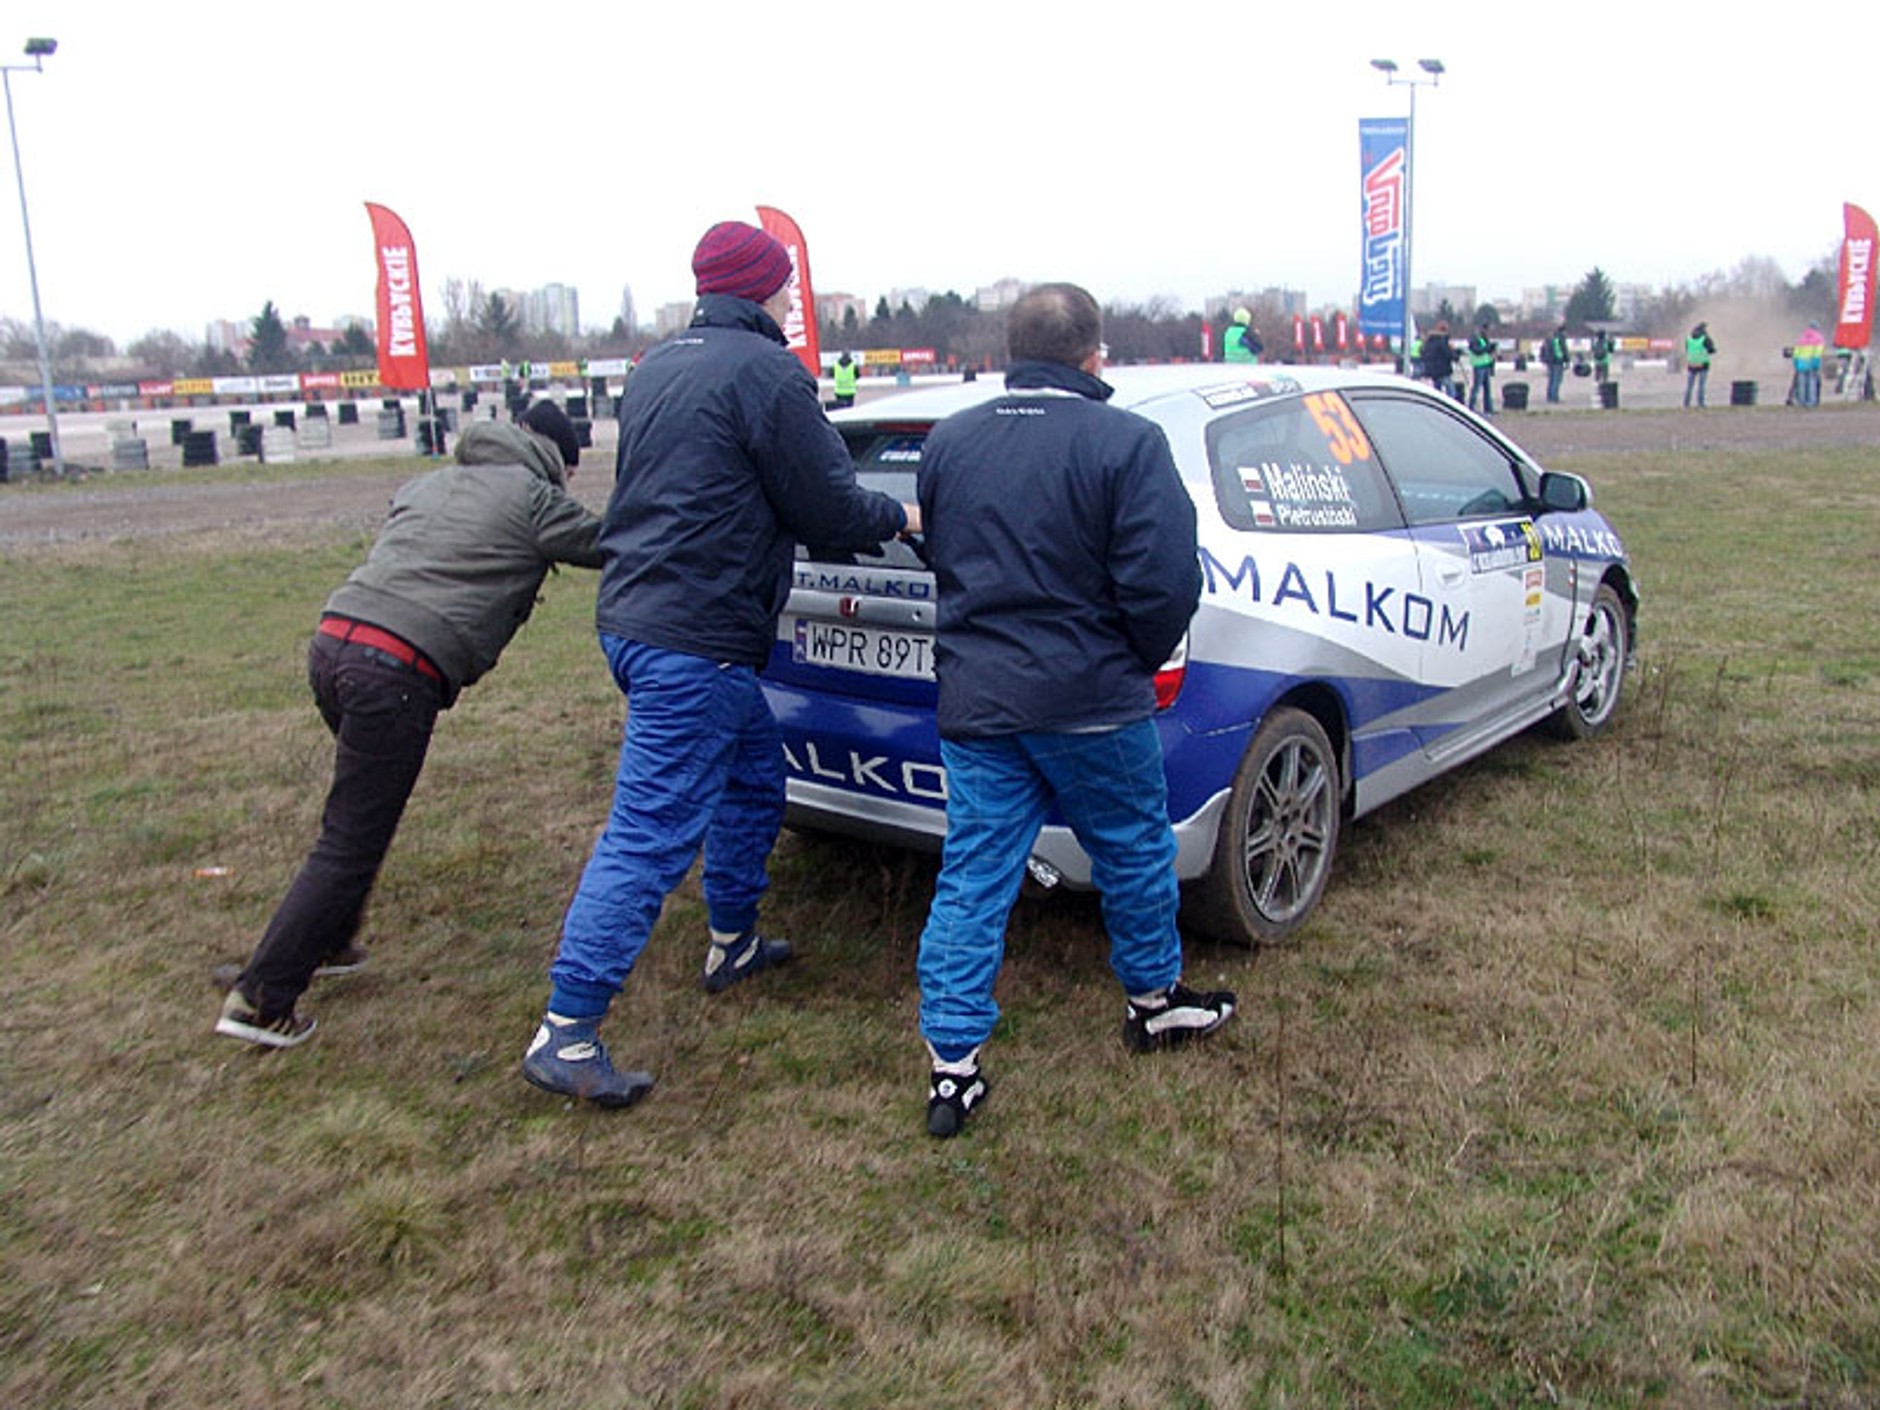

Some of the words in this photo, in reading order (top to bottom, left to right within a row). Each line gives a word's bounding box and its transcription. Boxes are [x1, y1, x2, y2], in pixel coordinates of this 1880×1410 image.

[1303, 391, 1370, 464] 53
[1199, 546, 1469, 652] MALKOM
[813, 625, 868, 666] WPR
[876, 634, 936, 673] 89T
